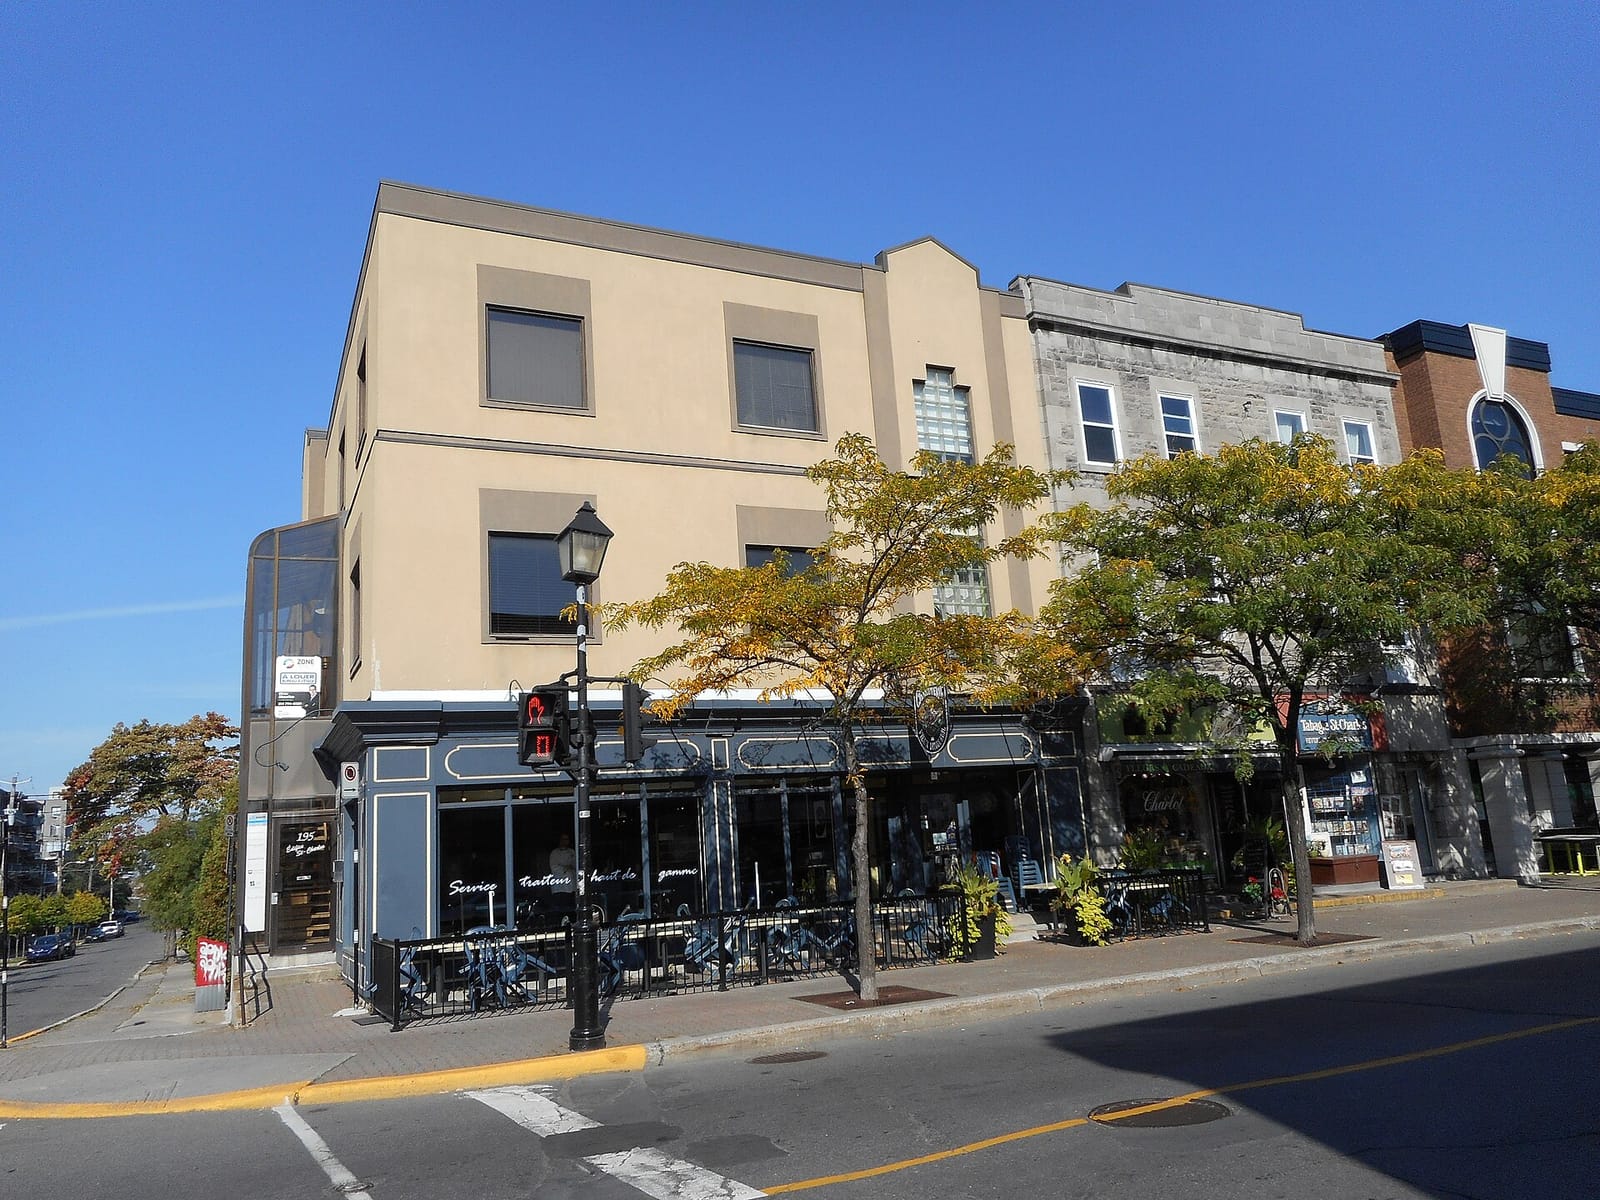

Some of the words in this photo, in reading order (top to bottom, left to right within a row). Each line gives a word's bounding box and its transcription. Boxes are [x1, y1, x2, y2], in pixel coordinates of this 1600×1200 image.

[1142, 790, 1185, 812] Charlot
[295, 831, 316, 842] 195
[448, 879, 498, 896] Service
[518, 873, 572, 888] traiteur
[590, 868, 621, 882] haut
[621, 867, 637, 880] de
[657, 867, 698, 883] gamme
